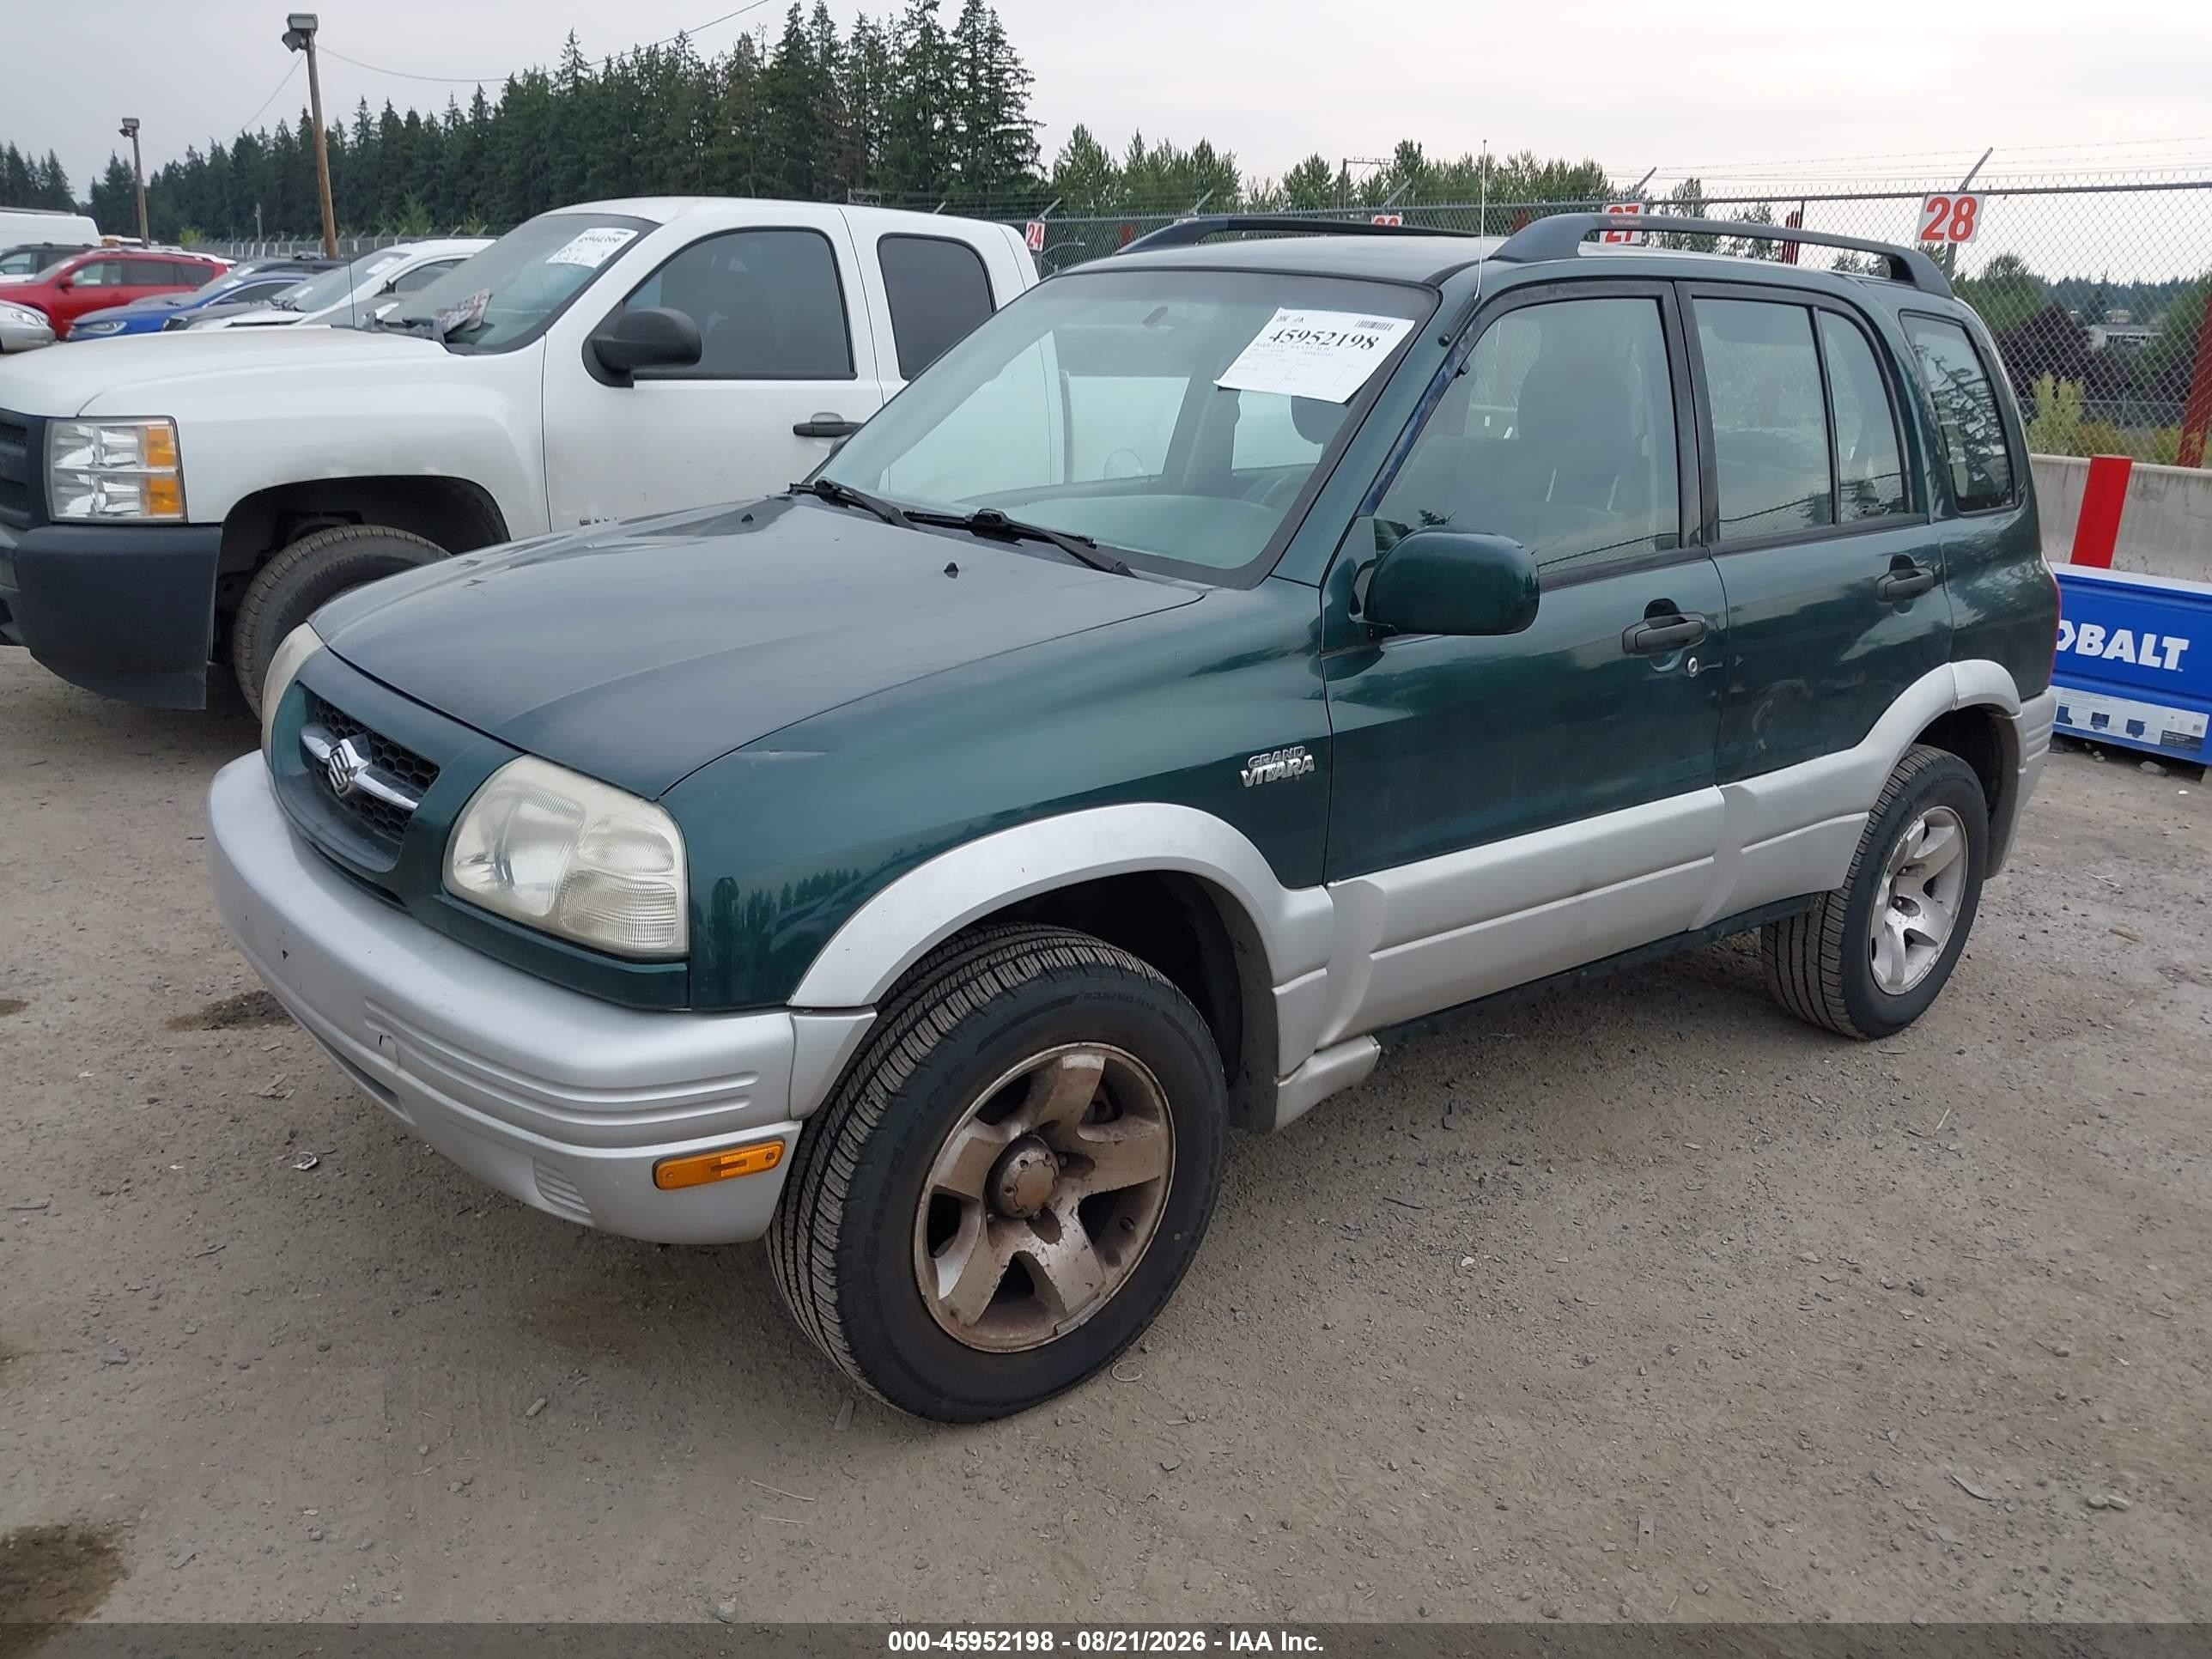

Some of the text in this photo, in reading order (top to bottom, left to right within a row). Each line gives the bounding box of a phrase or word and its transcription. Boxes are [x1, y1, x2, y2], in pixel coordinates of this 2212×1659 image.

[1920, 196, 1978, 241] 28
[1026, 223, 1042, 249] 24
[1268, 328, 1379, 350] 45952198
[1248, 745, 1306, 769] GRAND
[1240, 754, 1316, 787] VITARA
